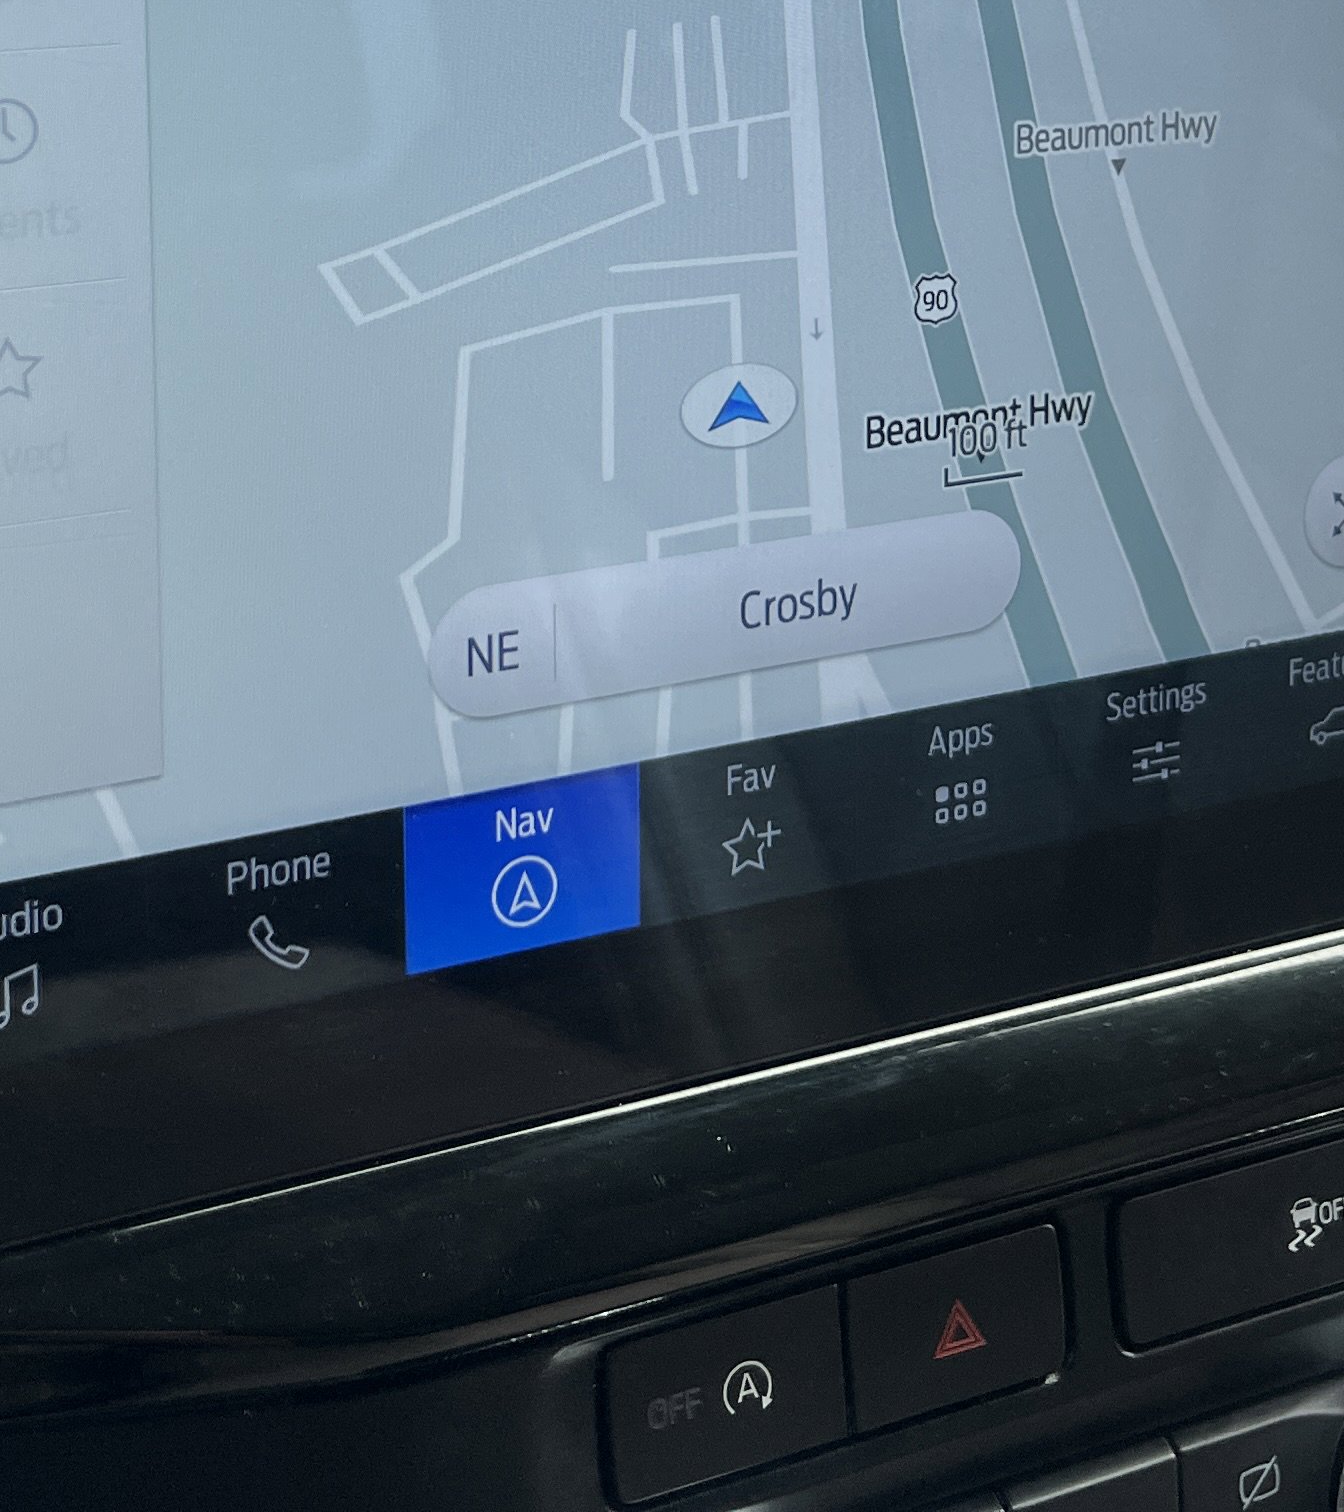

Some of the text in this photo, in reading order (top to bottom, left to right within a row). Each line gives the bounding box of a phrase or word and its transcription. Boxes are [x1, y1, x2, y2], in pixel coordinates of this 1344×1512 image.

[1015, 110, 1218, 155] Beaumont Hwy
[922, 288, 949, 312] 90
[1030, 392, 1093, 428] Hwy
[948, 418, 1028, 458] 100 ft
[740, 578, 858, 630] Crosby
[467, 629, 520, 678] NE
[1105, 679, 1208, 722] Settings
[928, 719, 994, 759] Apps
[726, 763, 777, 797] Fav
[494, 804, 555, 843] Nav
[226, 848, 332, 895] Phone
[647, 1387, 703, 1430] OFF
